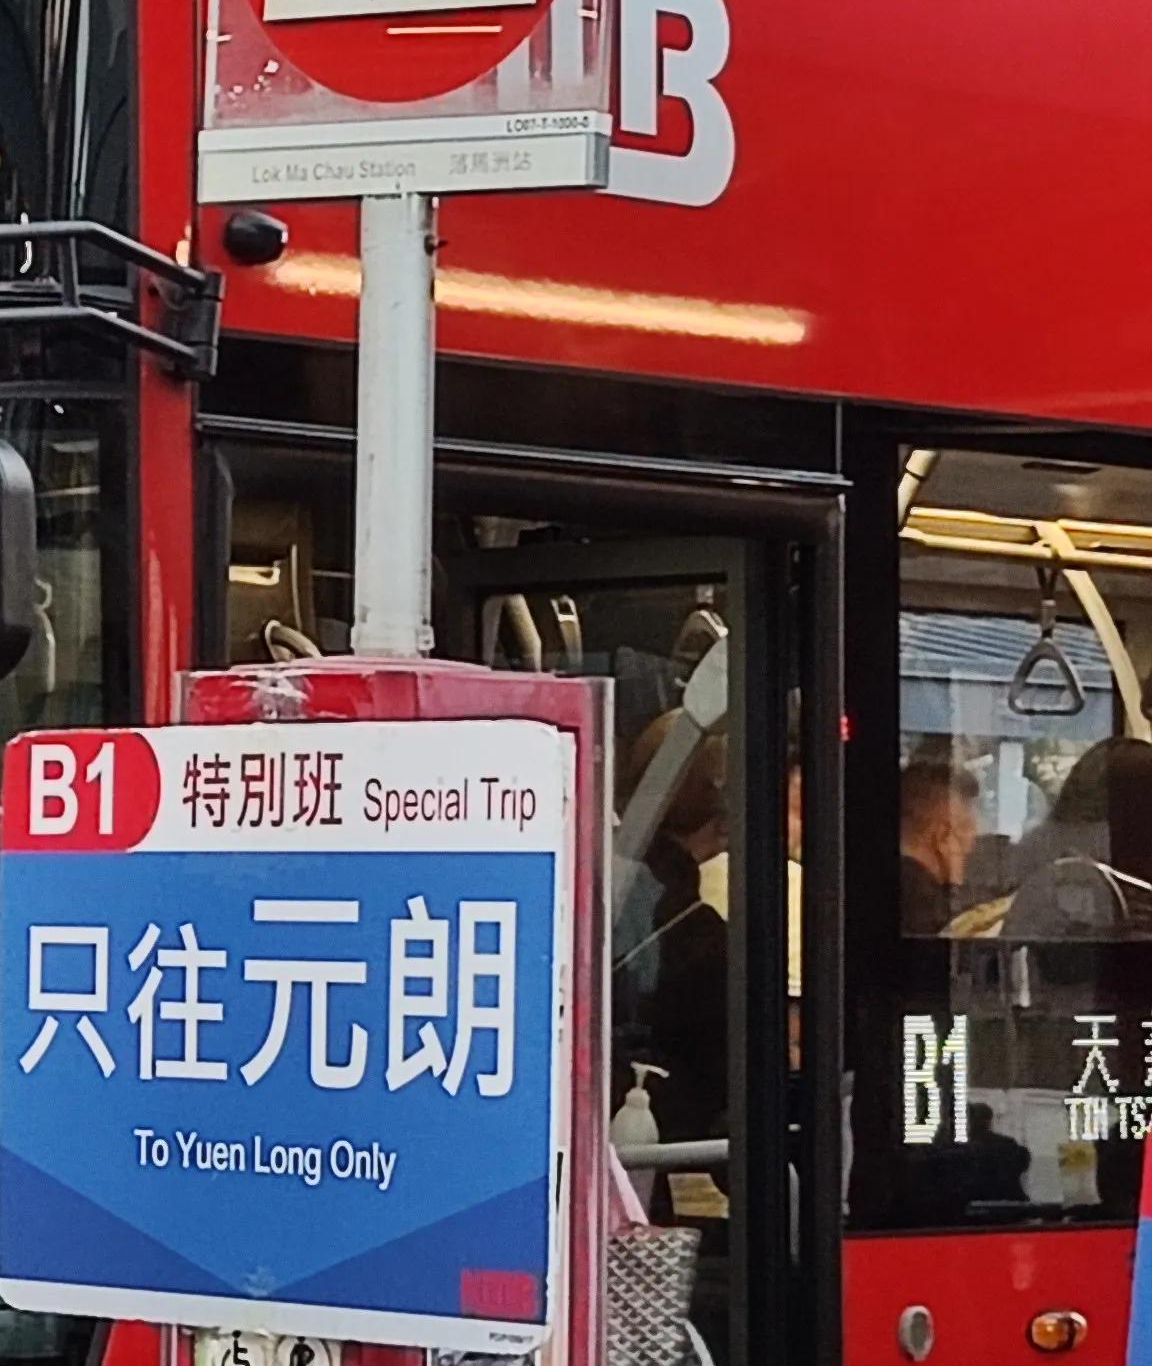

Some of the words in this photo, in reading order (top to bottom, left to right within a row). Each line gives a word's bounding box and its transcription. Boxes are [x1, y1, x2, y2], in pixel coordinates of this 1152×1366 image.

[359, 157, 416, 179] Station
[28, 740, 116, 835] B1
[183, 751, 344, 828] 特別班
[363, 777, 469, 832] Special
[480, 777, 537, 832] Trip
[19, 896, 517, 1097] 只往元朗
[903, 1014, 968, 1144] B1
[1064, 1097, 1109, 1140] TIN
[1114, 1097, 1152, 1140] TS
[134, 1129, 169, 1167] To
[175, 1131, 246, 1172] Yuen
[254, 1135, 322, 1186] Long
[330, 1140, 397, 1191] Only
